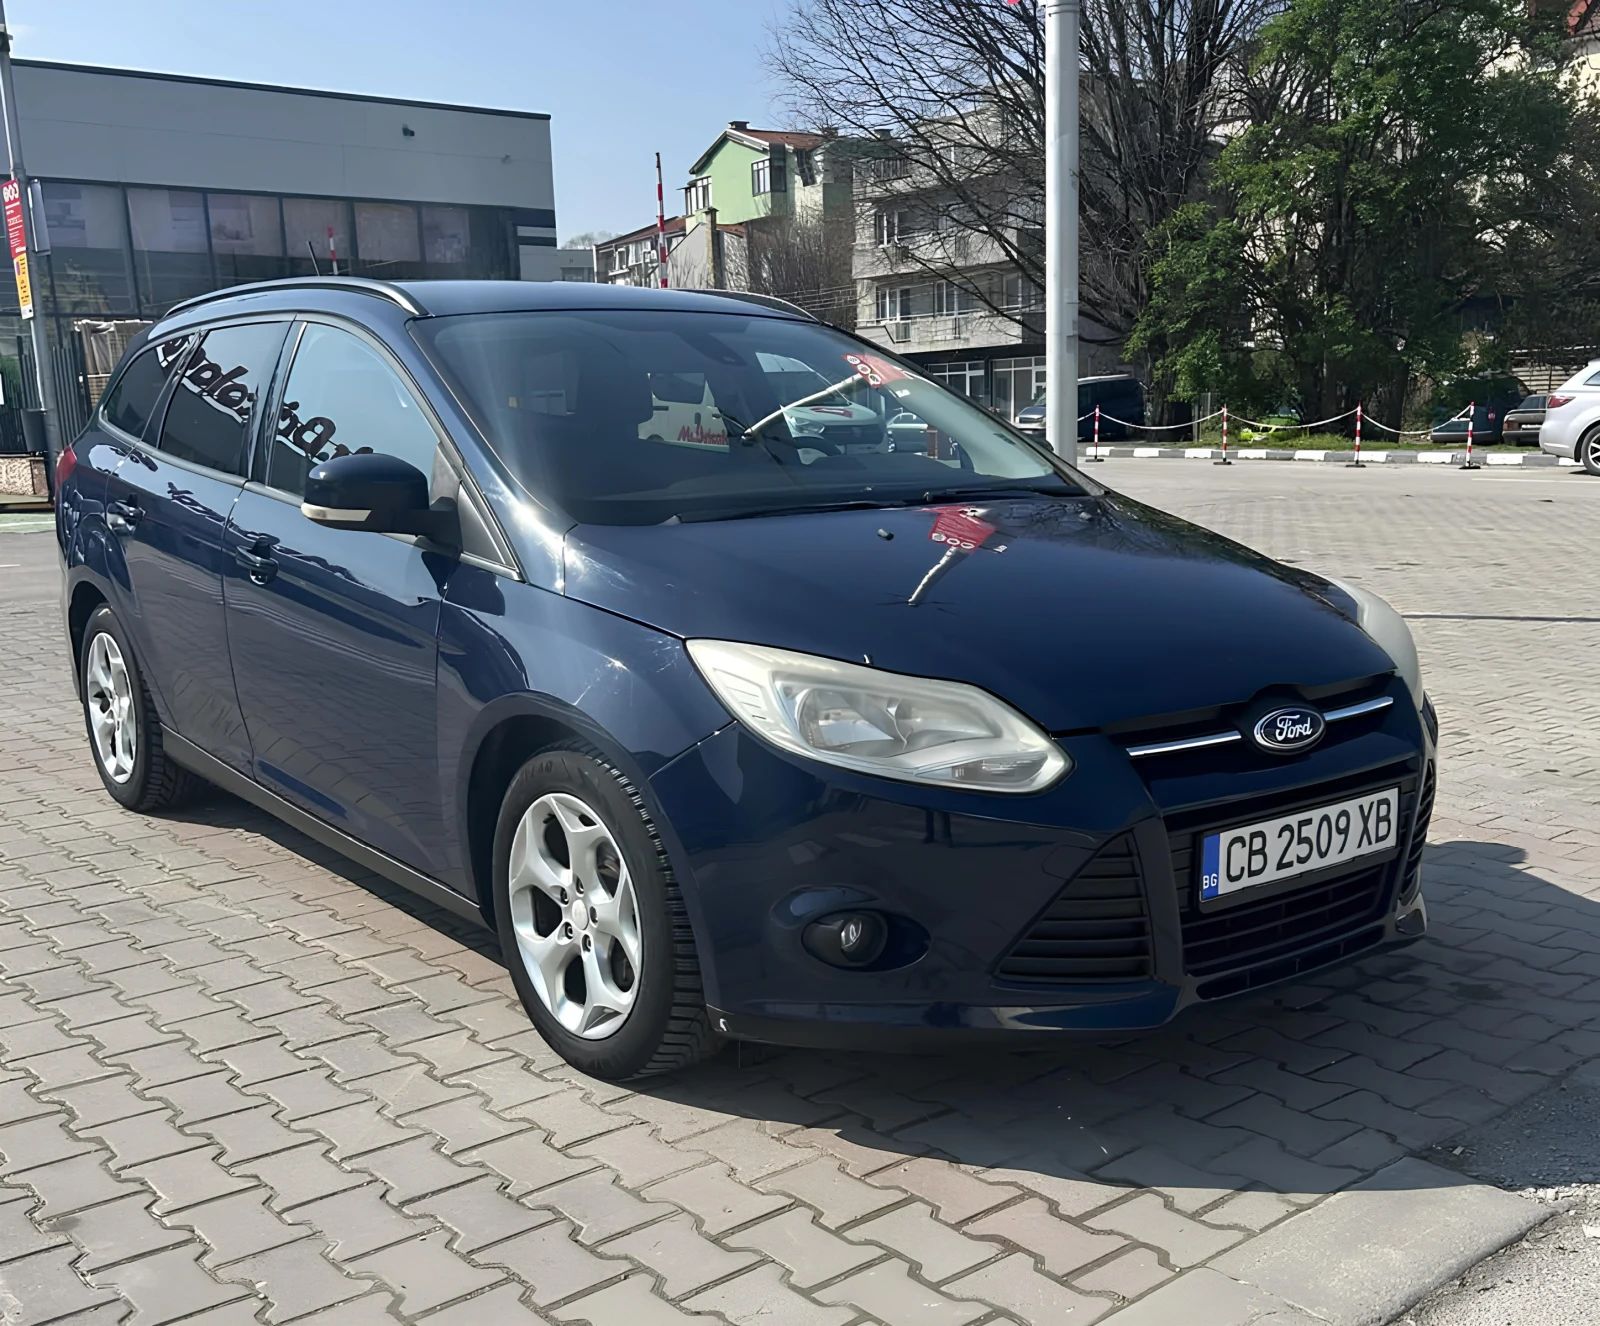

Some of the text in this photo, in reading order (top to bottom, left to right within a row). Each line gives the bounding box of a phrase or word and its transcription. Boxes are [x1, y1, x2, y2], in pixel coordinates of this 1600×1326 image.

[1276, 714, 1313, 742] Ford
[1226, 797, 1392, 883] CB 2509 XB
[1202, 873, 1218, 890] BG
